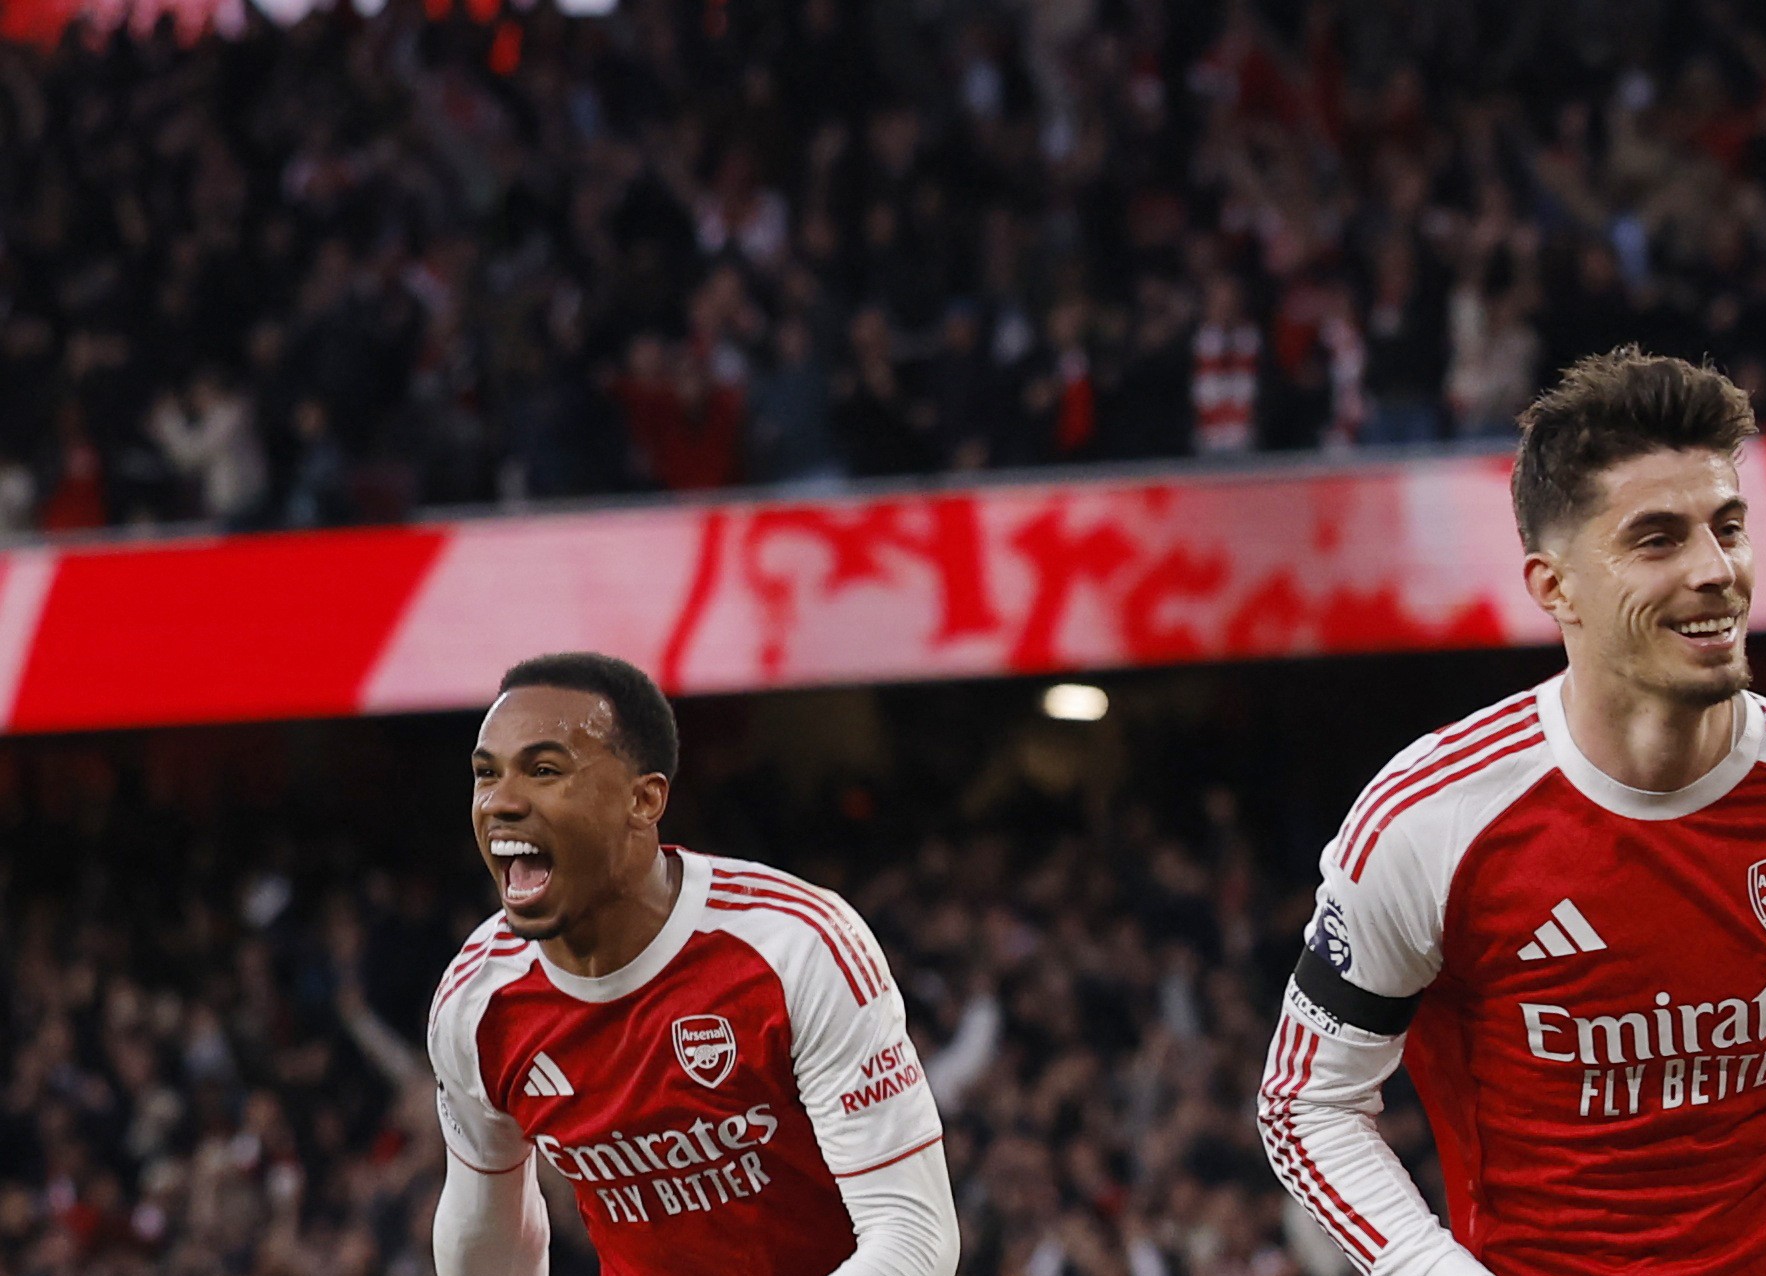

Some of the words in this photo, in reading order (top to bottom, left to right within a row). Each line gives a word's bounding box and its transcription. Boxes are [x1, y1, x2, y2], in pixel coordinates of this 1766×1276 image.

[681, 1026, 725, 1042] Arsenal
[861, 1041, 906, 1079] VISIT
[1580, 1064, 1646, 1117] FLY
[534, 1103, 778, 1181] Emirates
[597, 1184, 649, 1223] FLY
[652, 1151, 771, 1216] BETTER
